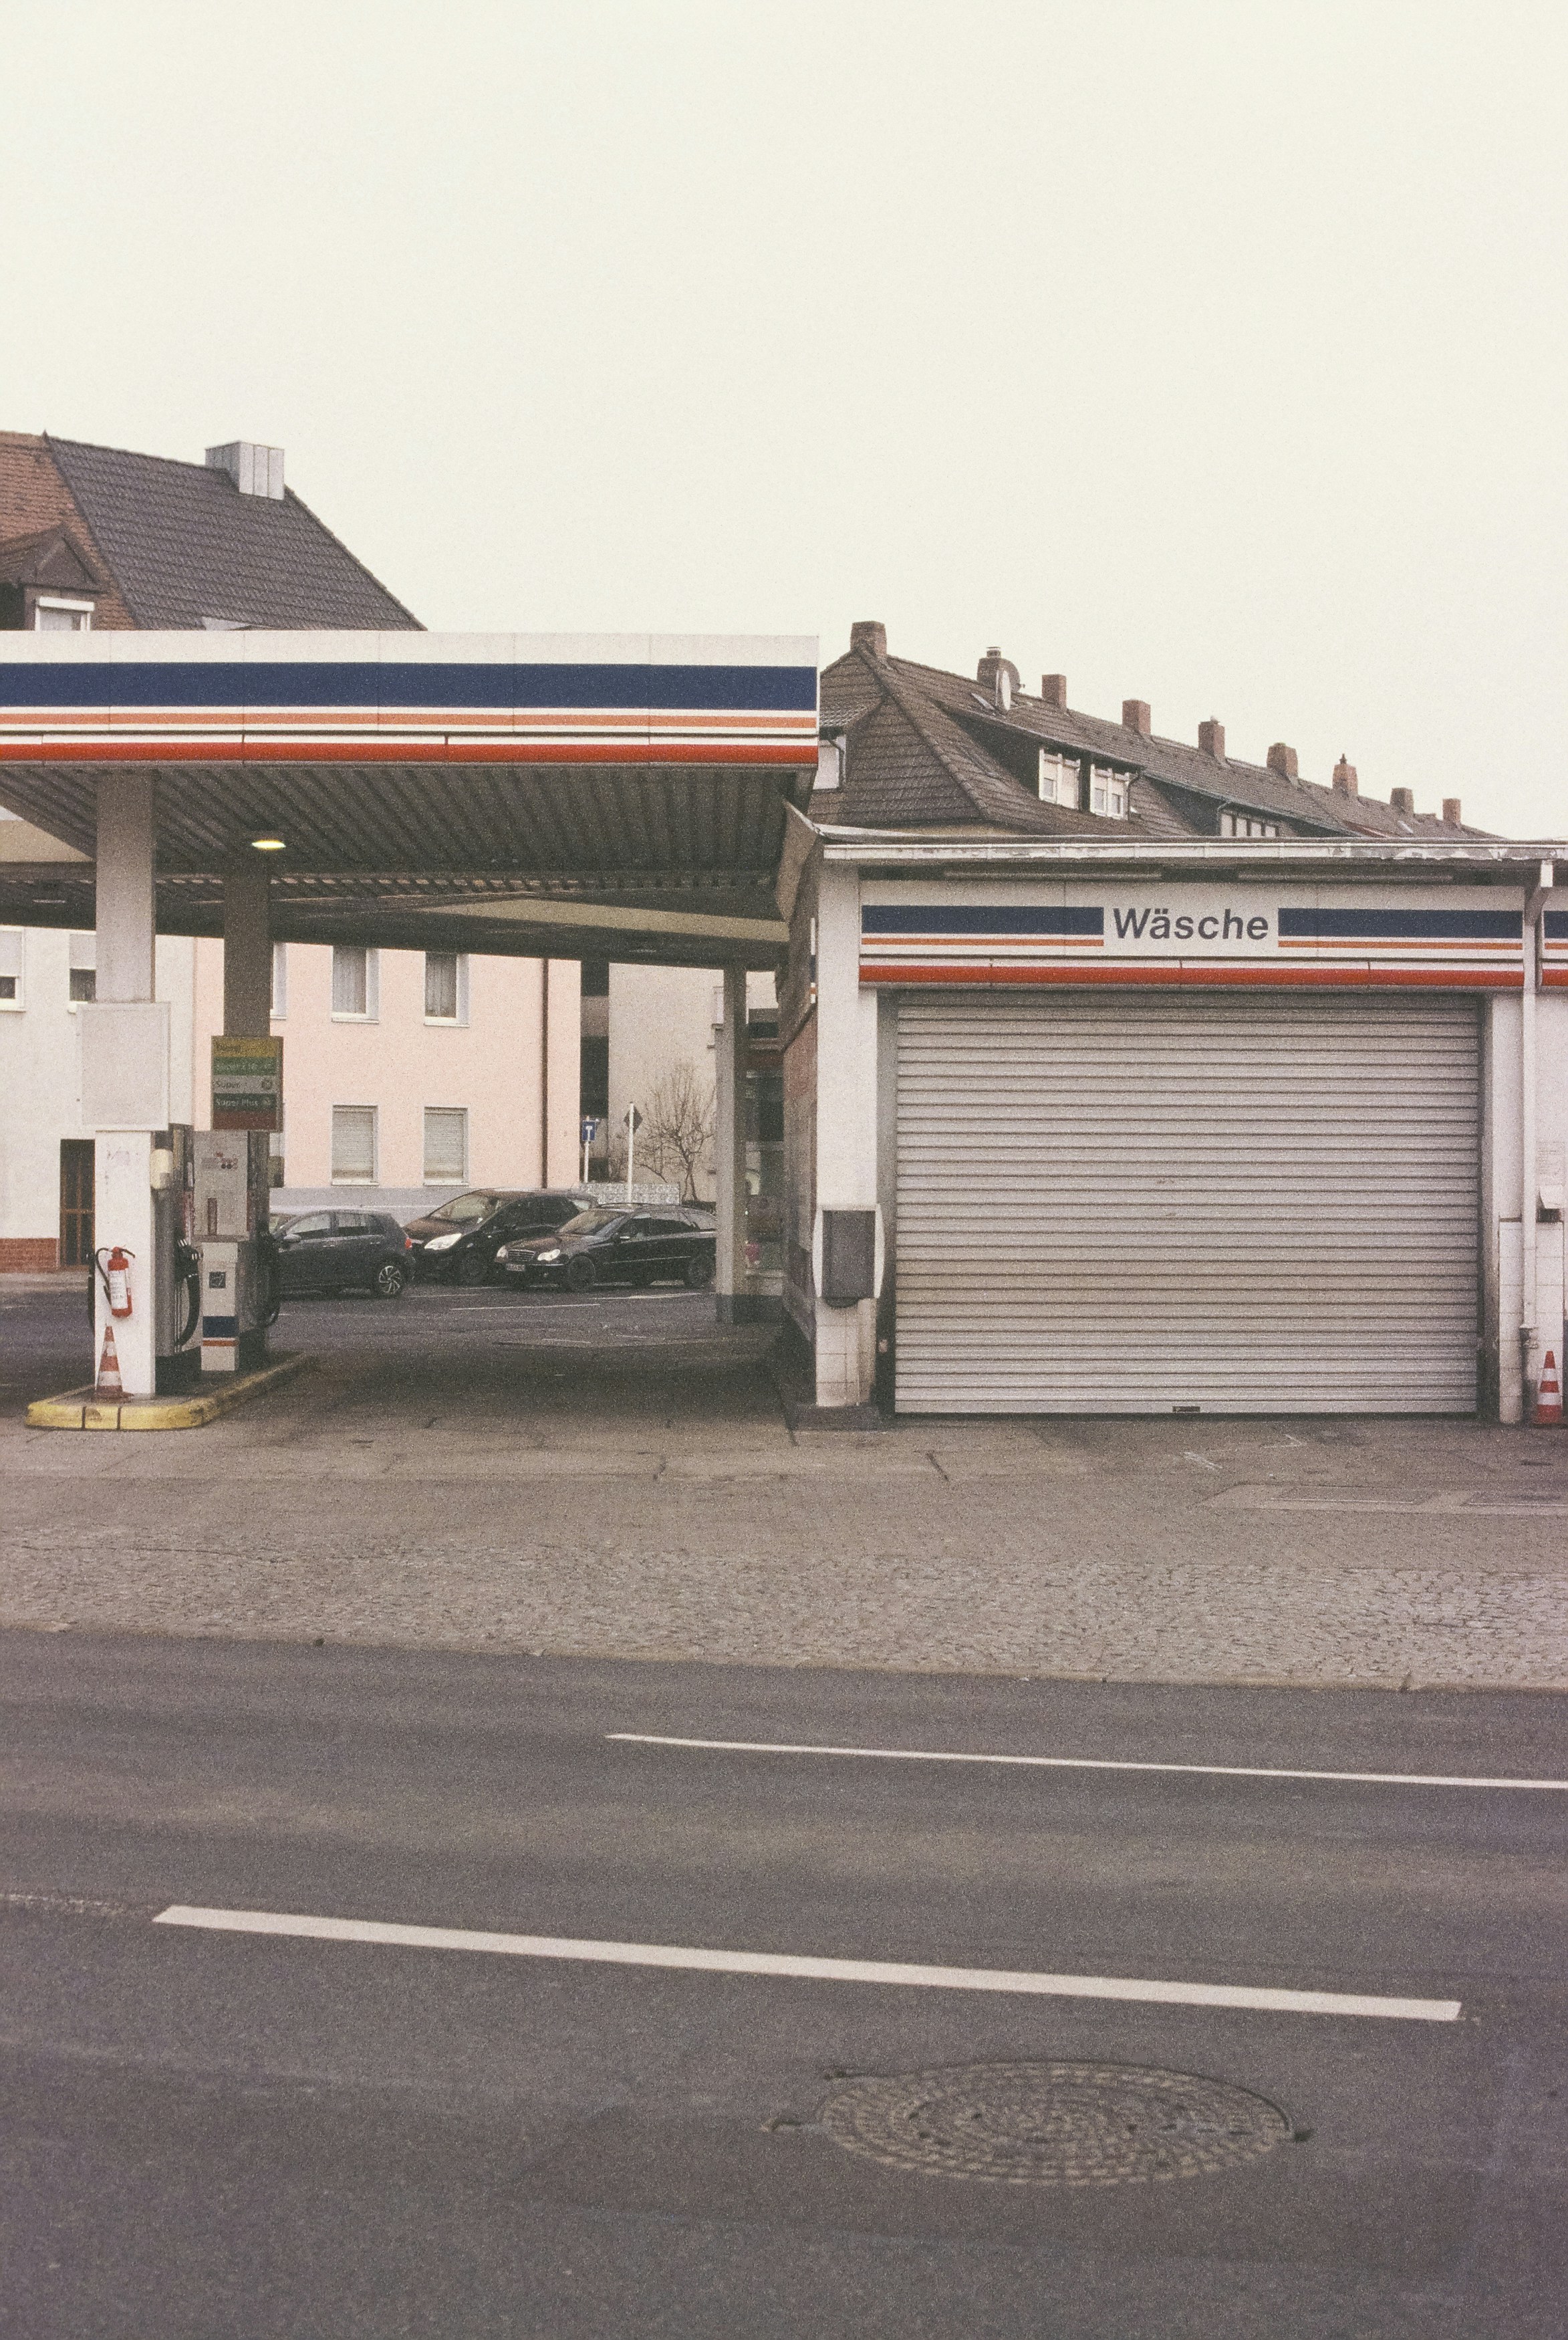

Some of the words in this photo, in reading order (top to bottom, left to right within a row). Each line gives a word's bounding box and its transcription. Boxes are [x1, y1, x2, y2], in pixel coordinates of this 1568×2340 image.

[1113, 908, 1269, 940] Wäsche
[216, 1098, 239, 1107] Super
[241, 1098, 258, 1106] Plus
